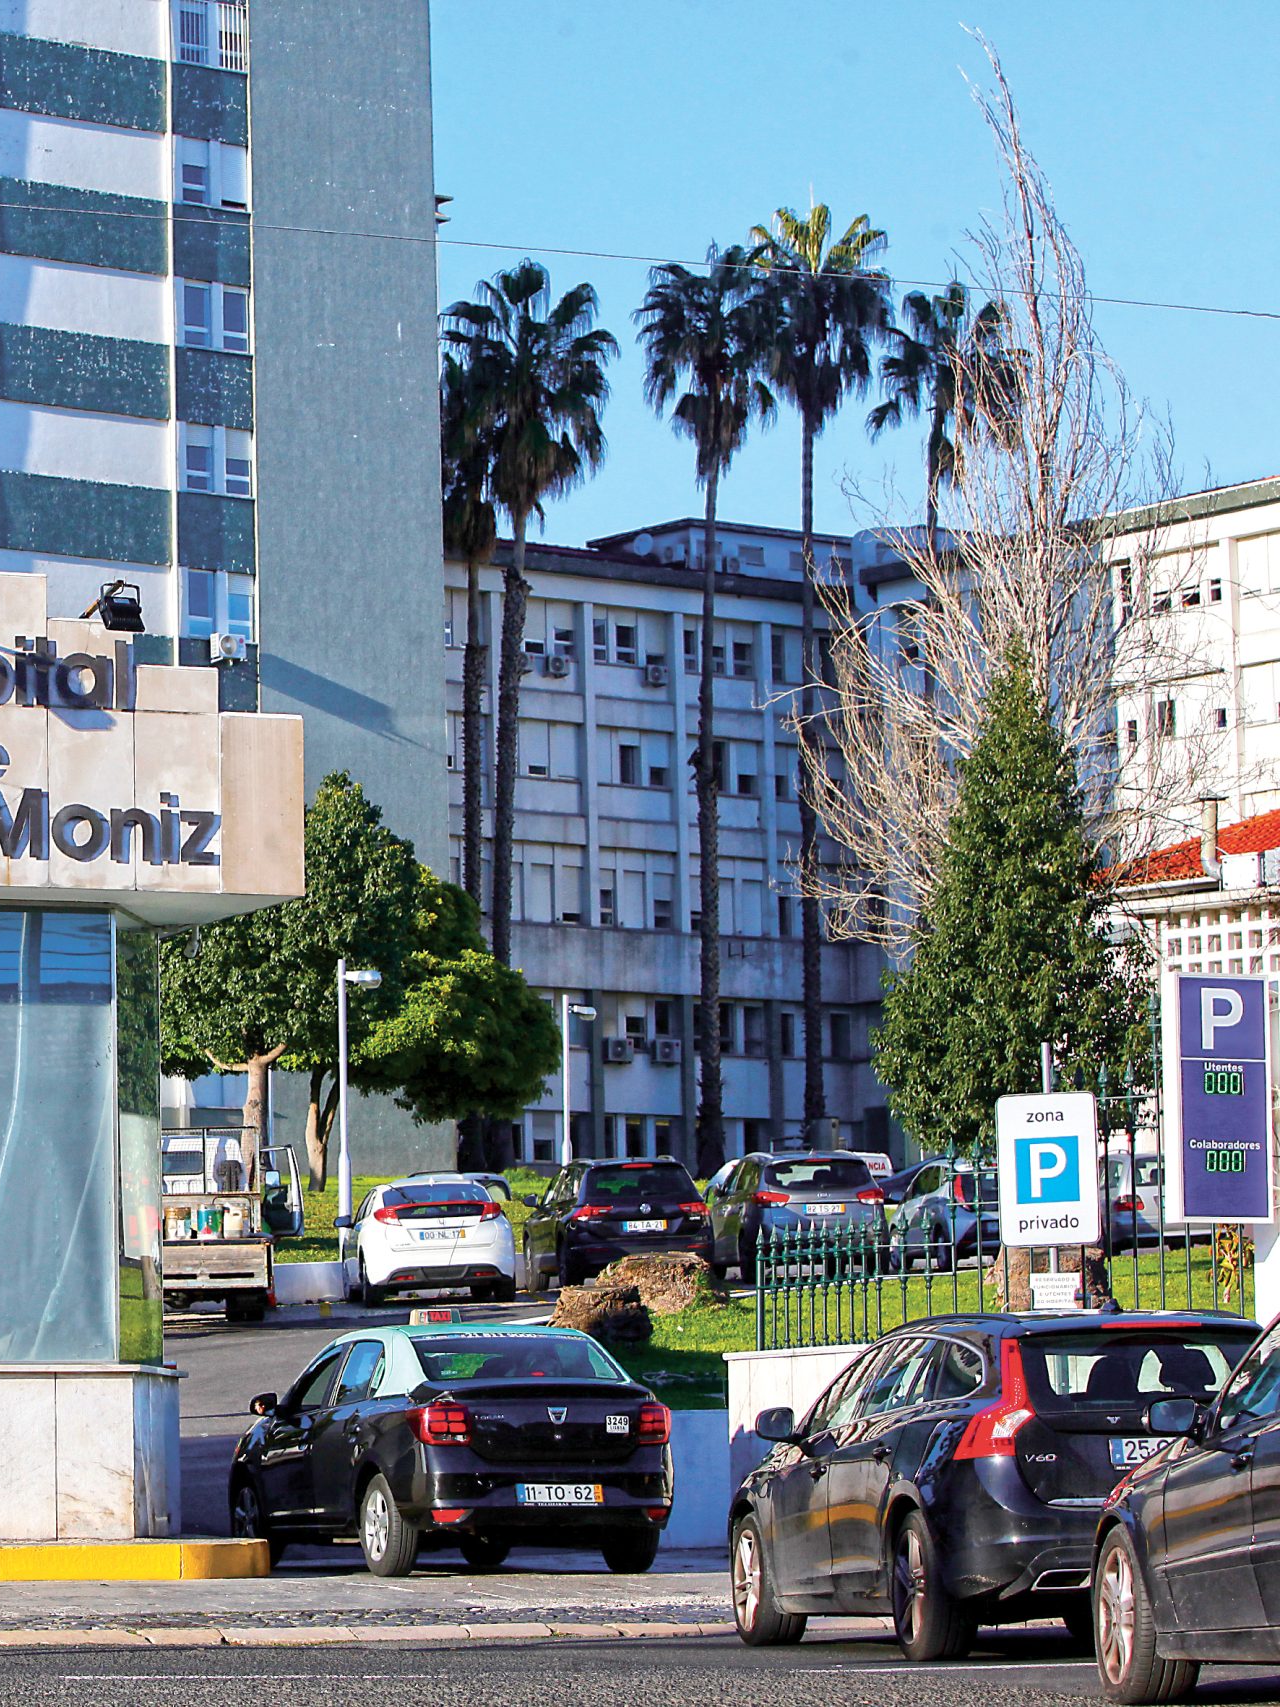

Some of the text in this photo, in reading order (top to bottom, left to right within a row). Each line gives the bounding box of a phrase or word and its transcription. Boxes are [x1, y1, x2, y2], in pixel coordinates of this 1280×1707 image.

[1201, 987, 1244, 1050] P
[1204, 1062, 1243, 1072] Utentes
[1205, 1073, 1240, 1093] 000
[1026, 1110, 1064, 1123] zona
[1189, 1140, 1261, 1150] Colaboradores
[1207, 1150, 1242, 1172] 000
[1029, 1143, 1067, 1198] P
[1019, 1215, 1080, 1234] privado
[429, 1311, 451, 1321] TAXI
[607, 1416, 629, 1426] 3249
[1025, 1453, 1058, 1463] V60
